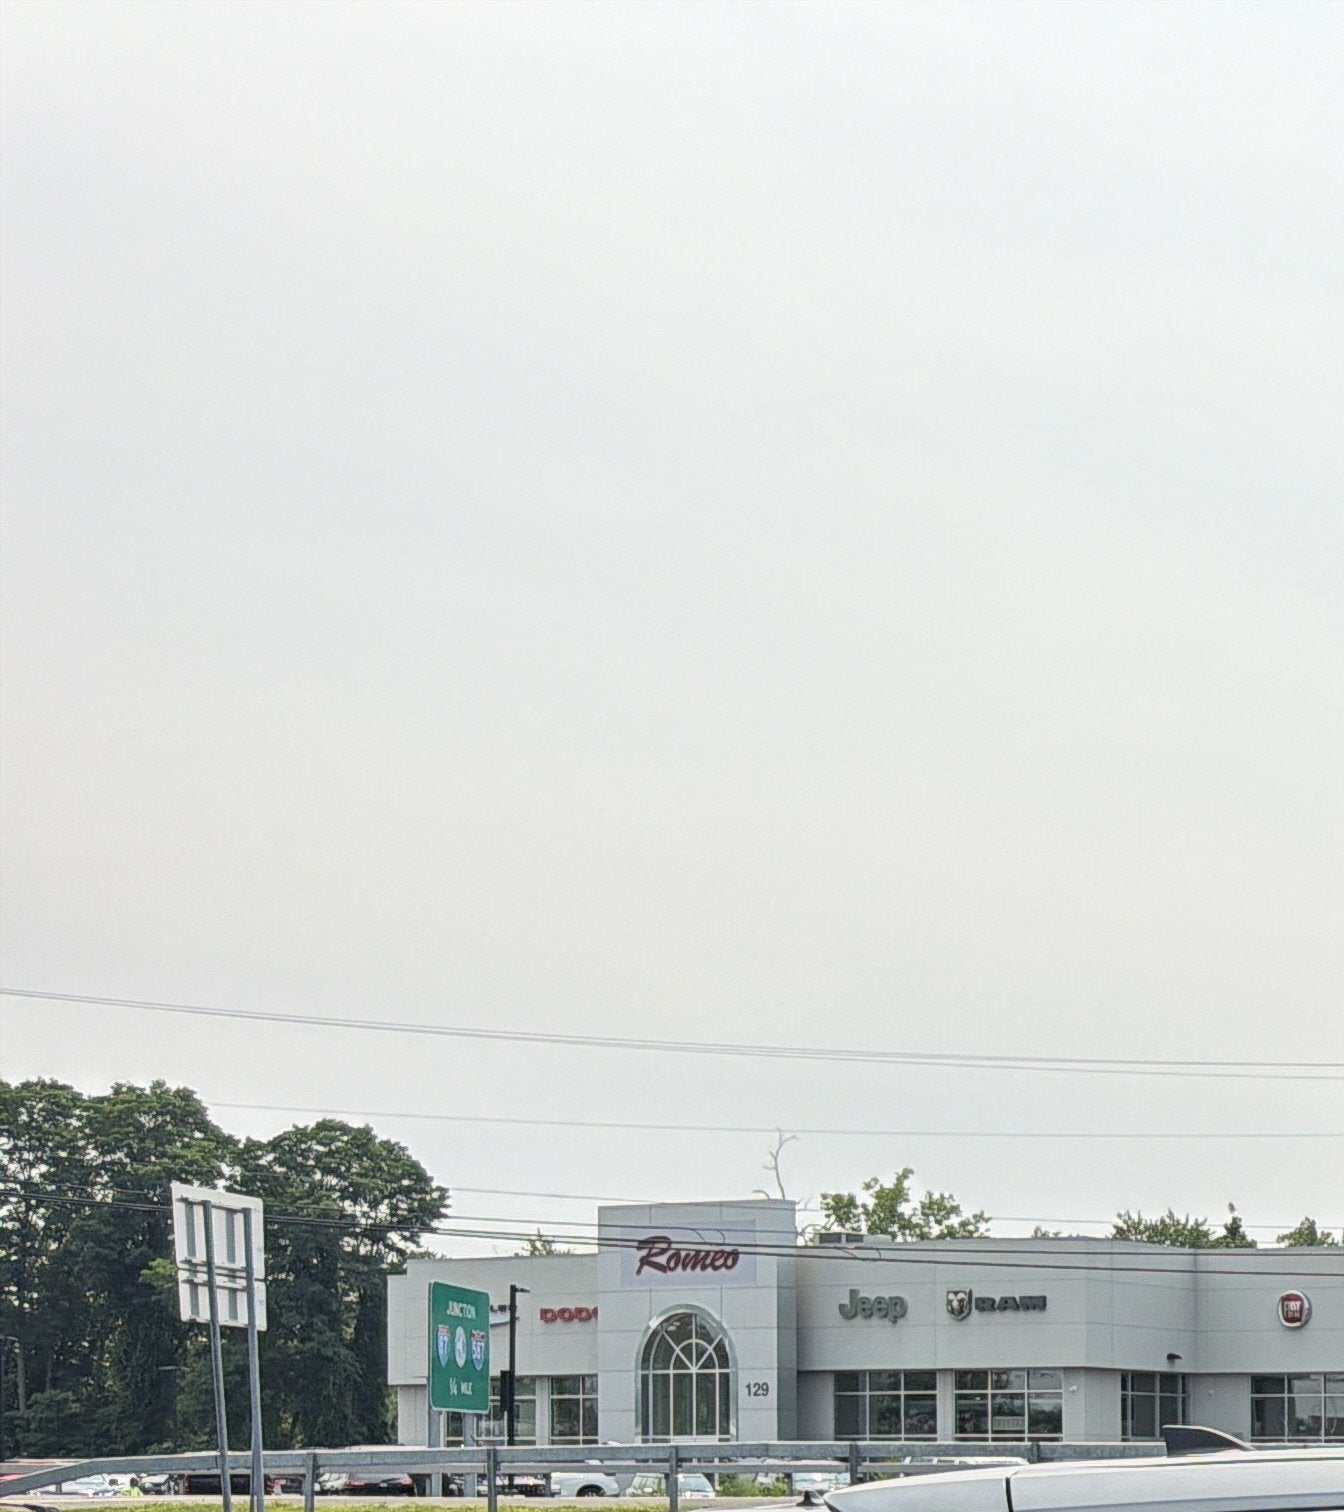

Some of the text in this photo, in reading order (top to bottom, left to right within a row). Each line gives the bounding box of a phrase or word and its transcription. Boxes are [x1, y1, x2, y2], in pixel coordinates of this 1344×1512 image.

[635, 1235, 740, 1276] Romeo
[838, 1288, 908, 1325] Jeep
[974, 1295, 1048, 1312] RAM
[539, 1306, 598, 1323] DOD
[745, 1382, 769, 1397] 129
